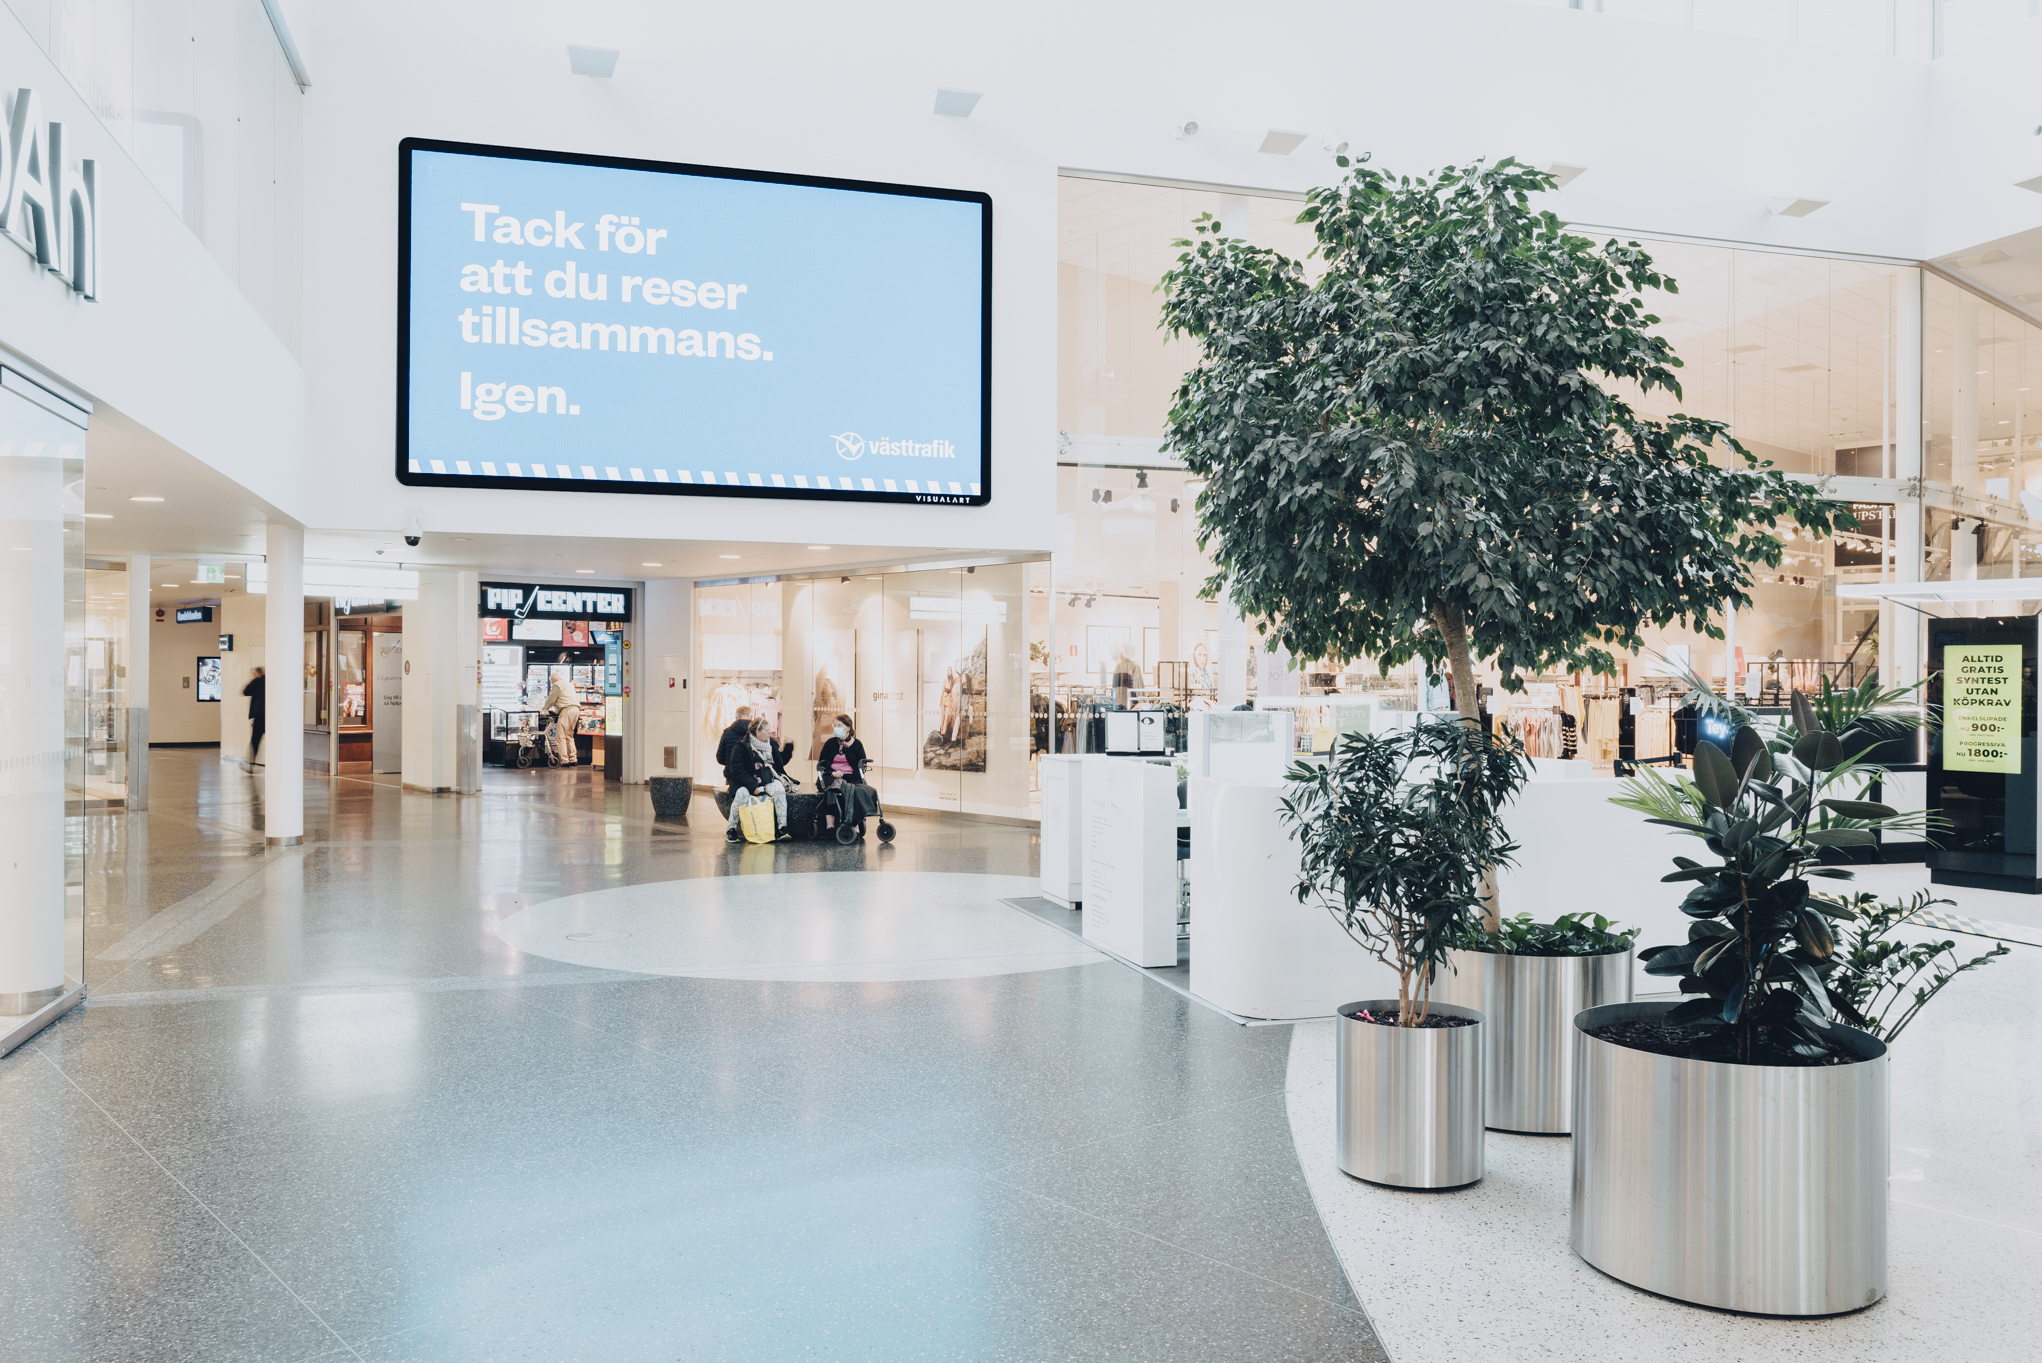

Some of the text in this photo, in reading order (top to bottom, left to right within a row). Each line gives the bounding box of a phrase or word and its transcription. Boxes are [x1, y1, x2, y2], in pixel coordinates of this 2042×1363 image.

[460, 202, 668, 257] Tack för
[459, 259, 748, 311] att du reser
[457, 305, 774, 362] tillsammans.
[460, 371, 581, 422] Igen.
[868, 437, 956, 459] västtrafik
[915, 495, 971, 504] VISUALART
[487, 587, 626, 614] PIP CENTER
[1961, 655, 2004, 663] ALLTID
[1961, 665, 2004, 674] GRATIS
[1956, 676, 2009, 685] SYNTEST
[1966, 687, 1998, 695] UTAN
[1953, 696, 2012, 707] KÖPKRAV
[1971, 723, 2005, 732] 900:-
[1959, 740, 2006, 748] PROGRESSIVA
[1967, 748, 2008, 758] 1800:-
